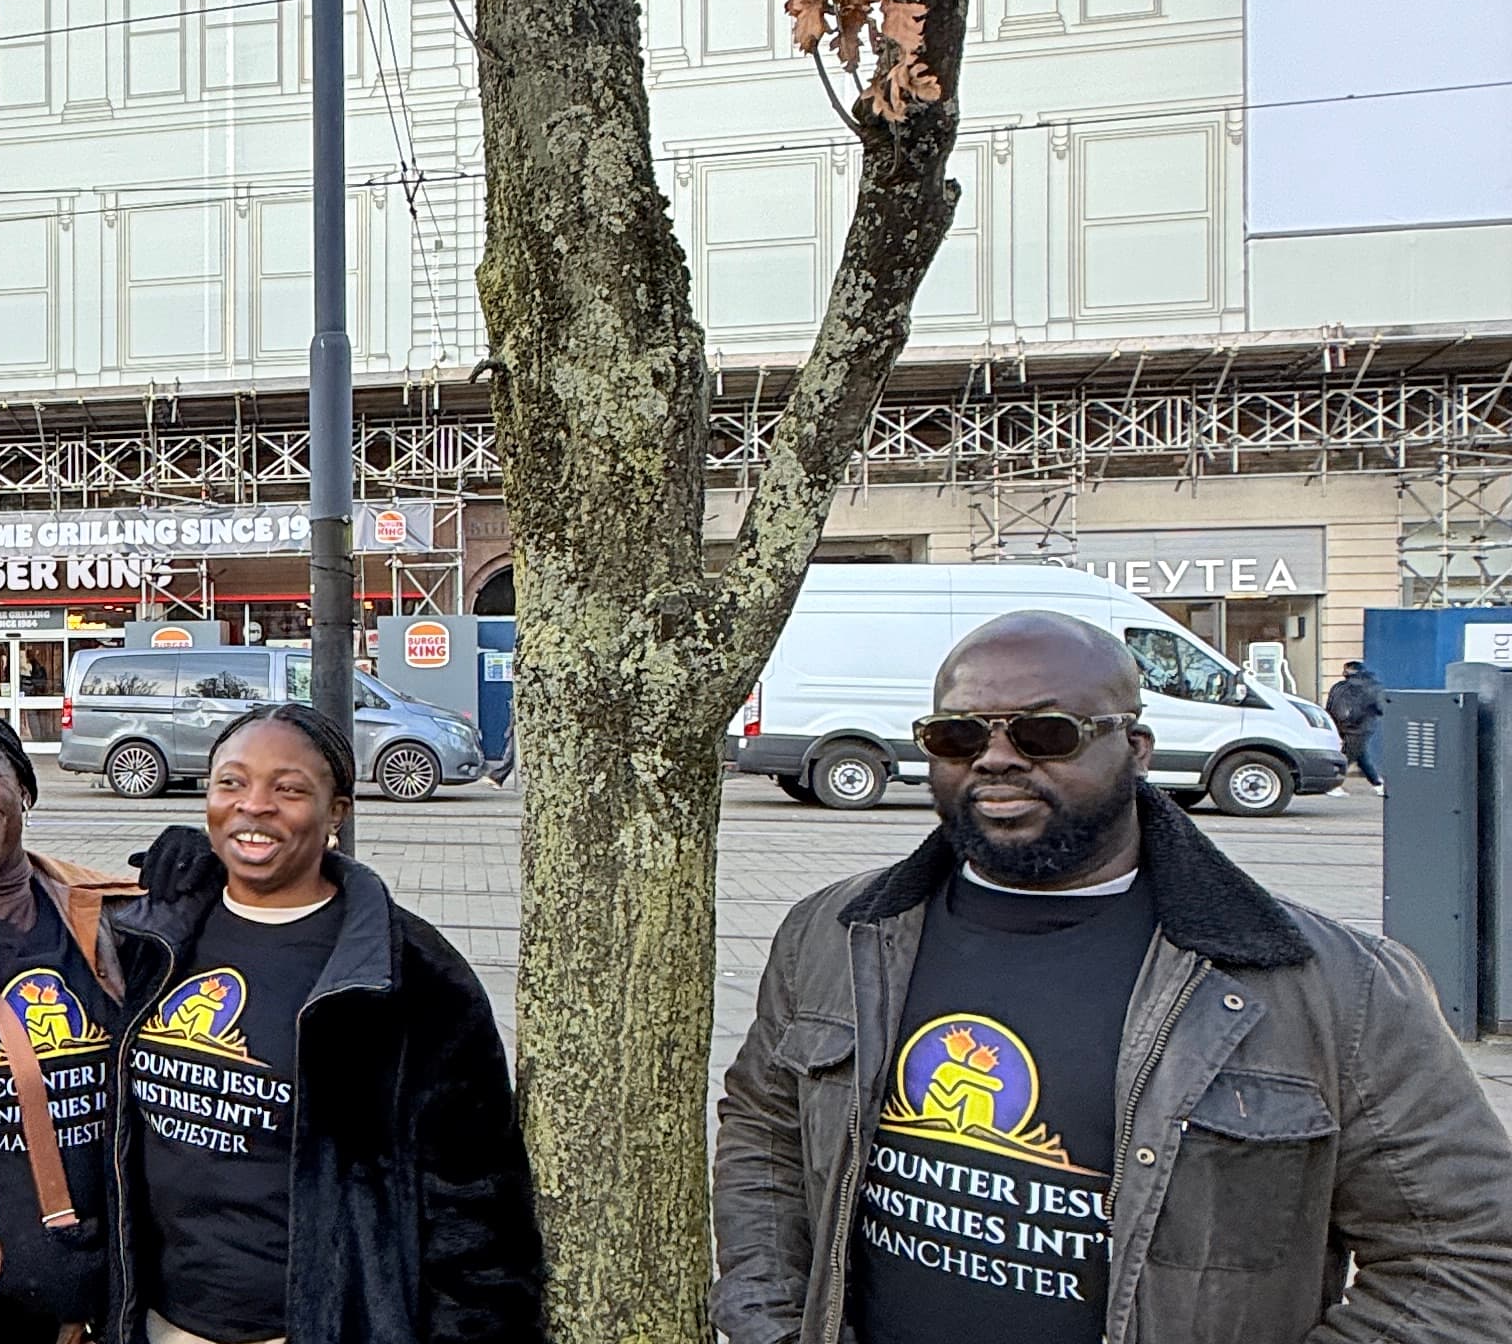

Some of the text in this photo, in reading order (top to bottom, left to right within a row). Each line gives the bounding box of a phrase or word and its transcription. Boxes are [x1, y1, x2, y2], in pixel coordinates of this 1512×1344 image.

[38, 519, 177, 548] GRILLING
[180, 517, 273, 544] SINCE
[278, 515, 311, 540] 19
[378, 528, 404, 536] KING
[8, 610, 51, 619] GRILLING
[408, 637, 446, 645] BURGER
[408, 646, 447, 657] KING
[220, 1070, 292, 1103] JESUS
[216, 1100, 278, 1131] INT'L
[861, 1216, 1085, 1301] MANCHESTER
